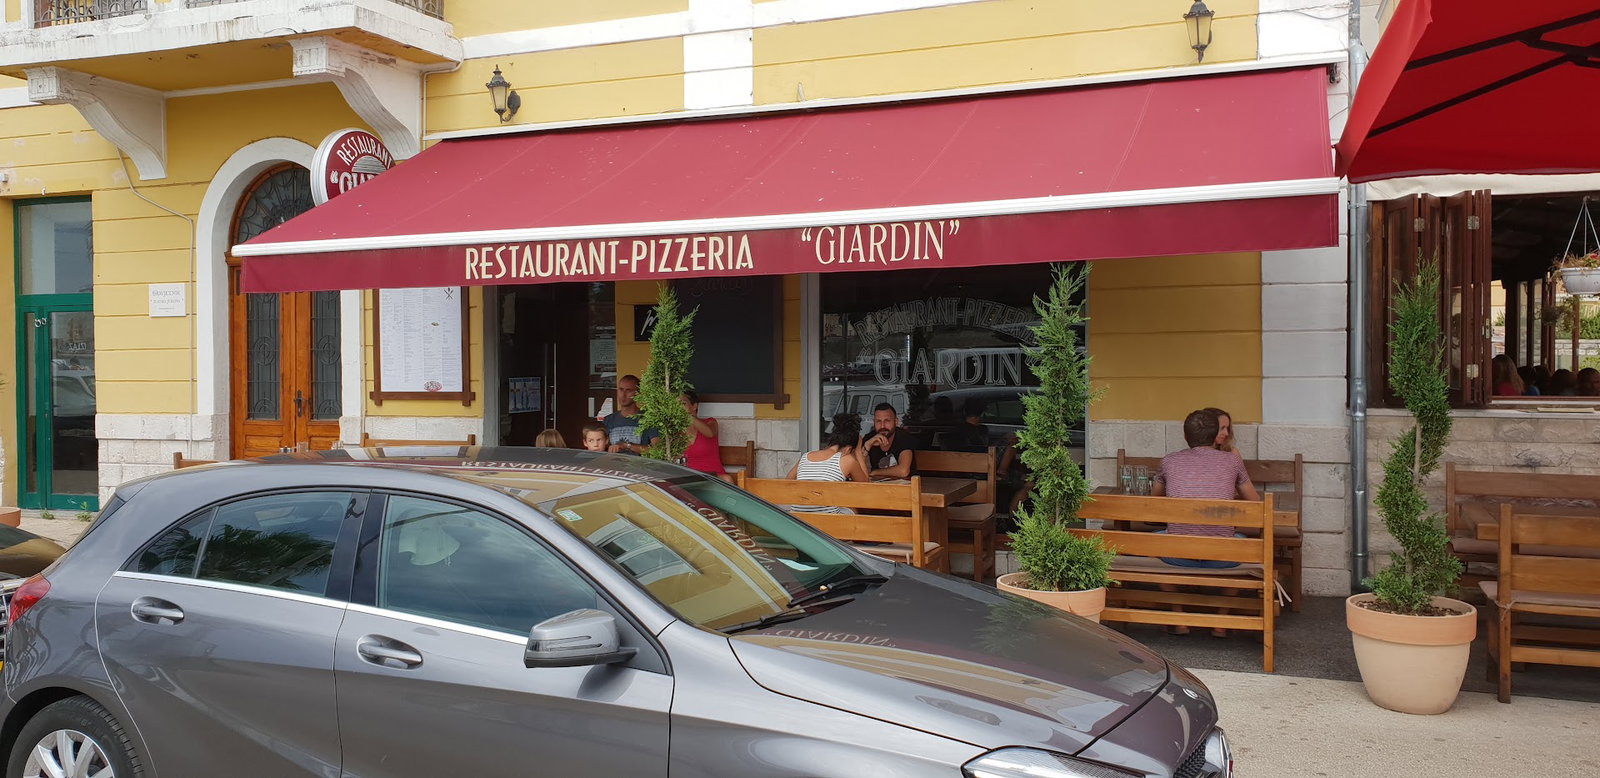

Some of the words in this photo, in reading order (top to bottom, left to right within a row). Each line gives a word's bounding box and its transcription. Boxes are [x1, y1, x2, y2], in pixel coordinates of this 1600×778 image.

[338, 136, 392, 169] RESTAURANT
[464, 234, 755, 280] RESTAURANT-PIZZERIA
[801, 219, 961, 266] “GIARDIN”
